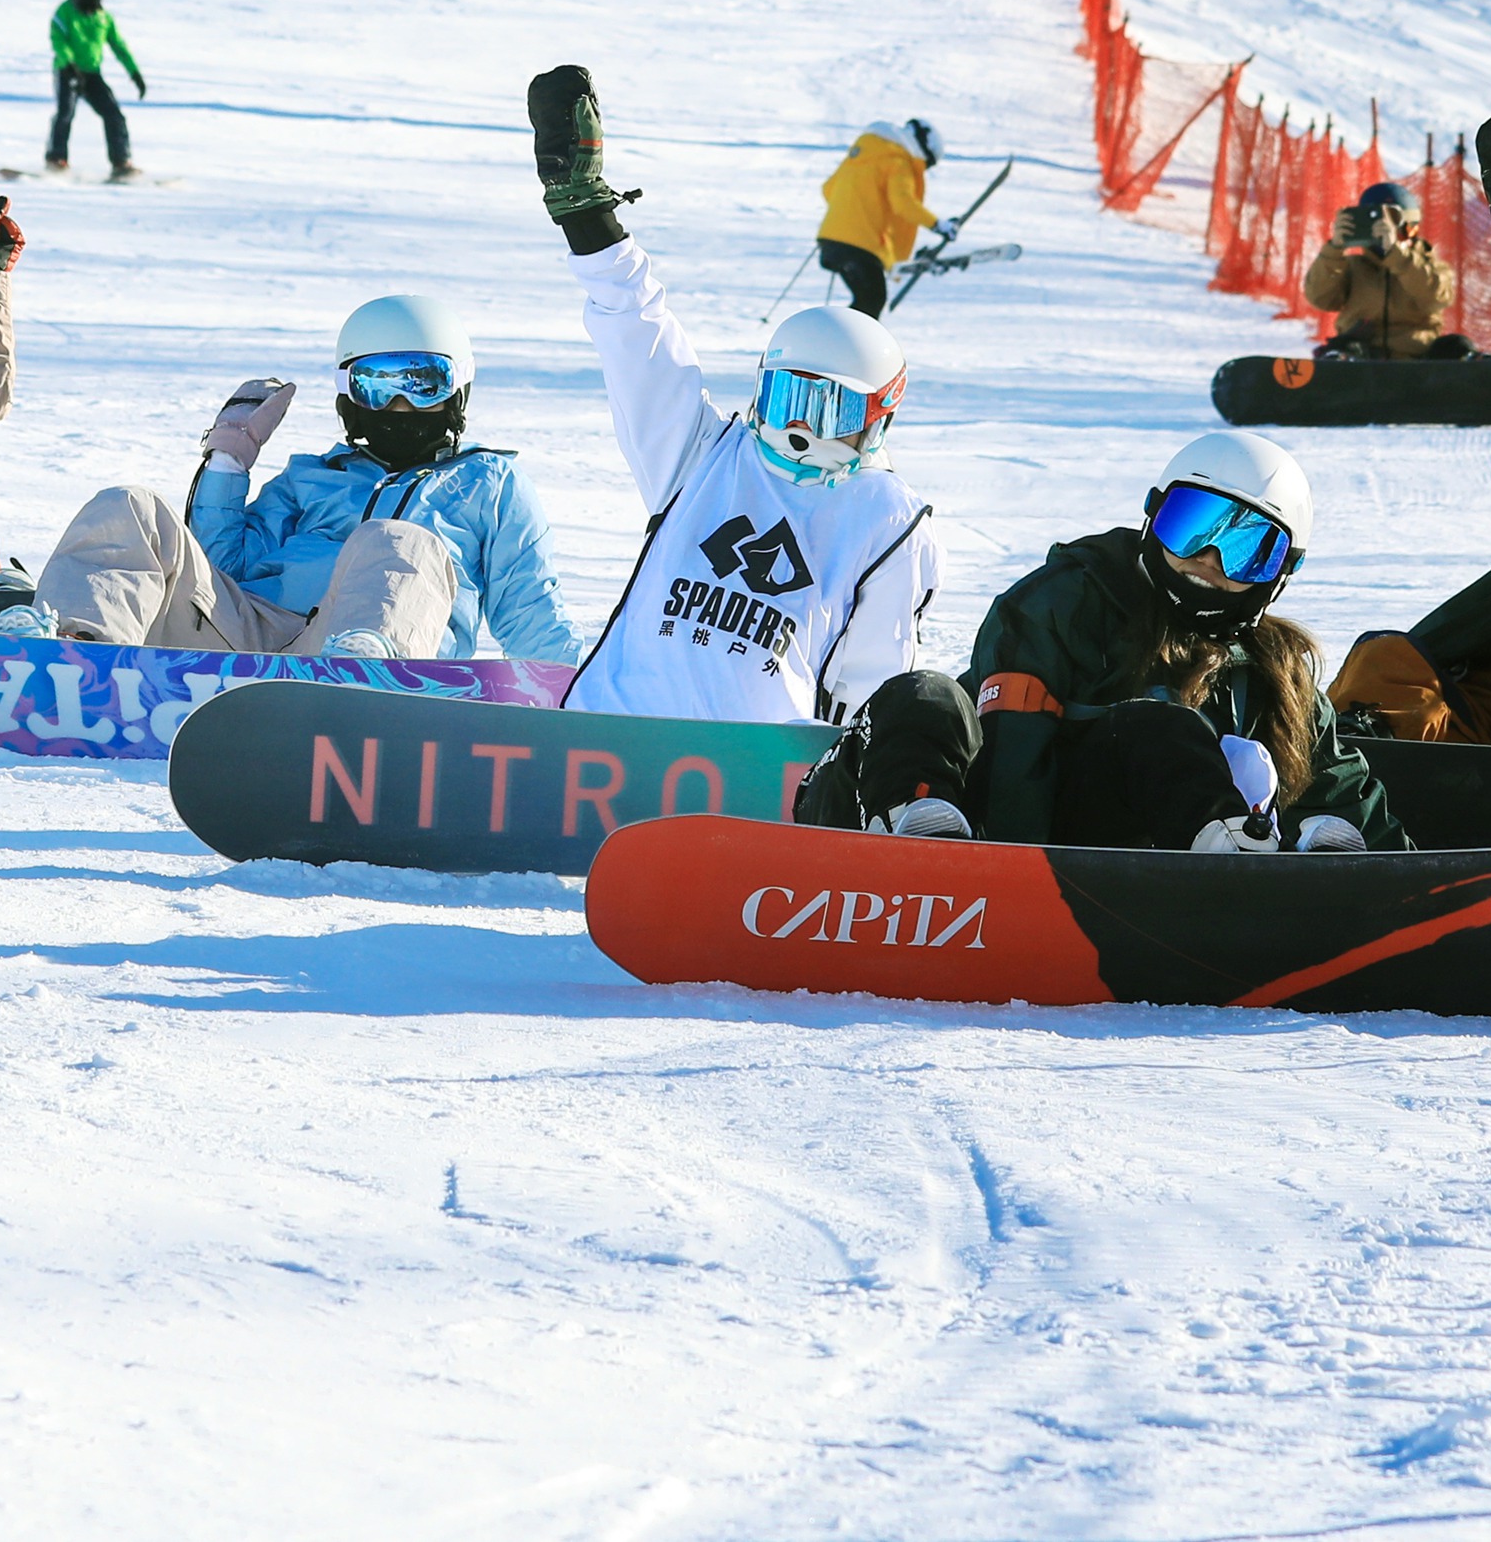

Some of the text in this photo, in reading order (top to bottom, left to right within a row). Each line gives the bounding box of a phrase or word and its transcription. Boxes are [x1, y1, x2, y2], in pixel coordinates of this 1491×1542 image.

[658, 620, 781, 677] 黑桃户外
[663, 577, 797, 659] SPADERS
[309, 734, 724, 837] NITRO
[741, 886, 987, 949] CAPiTA
